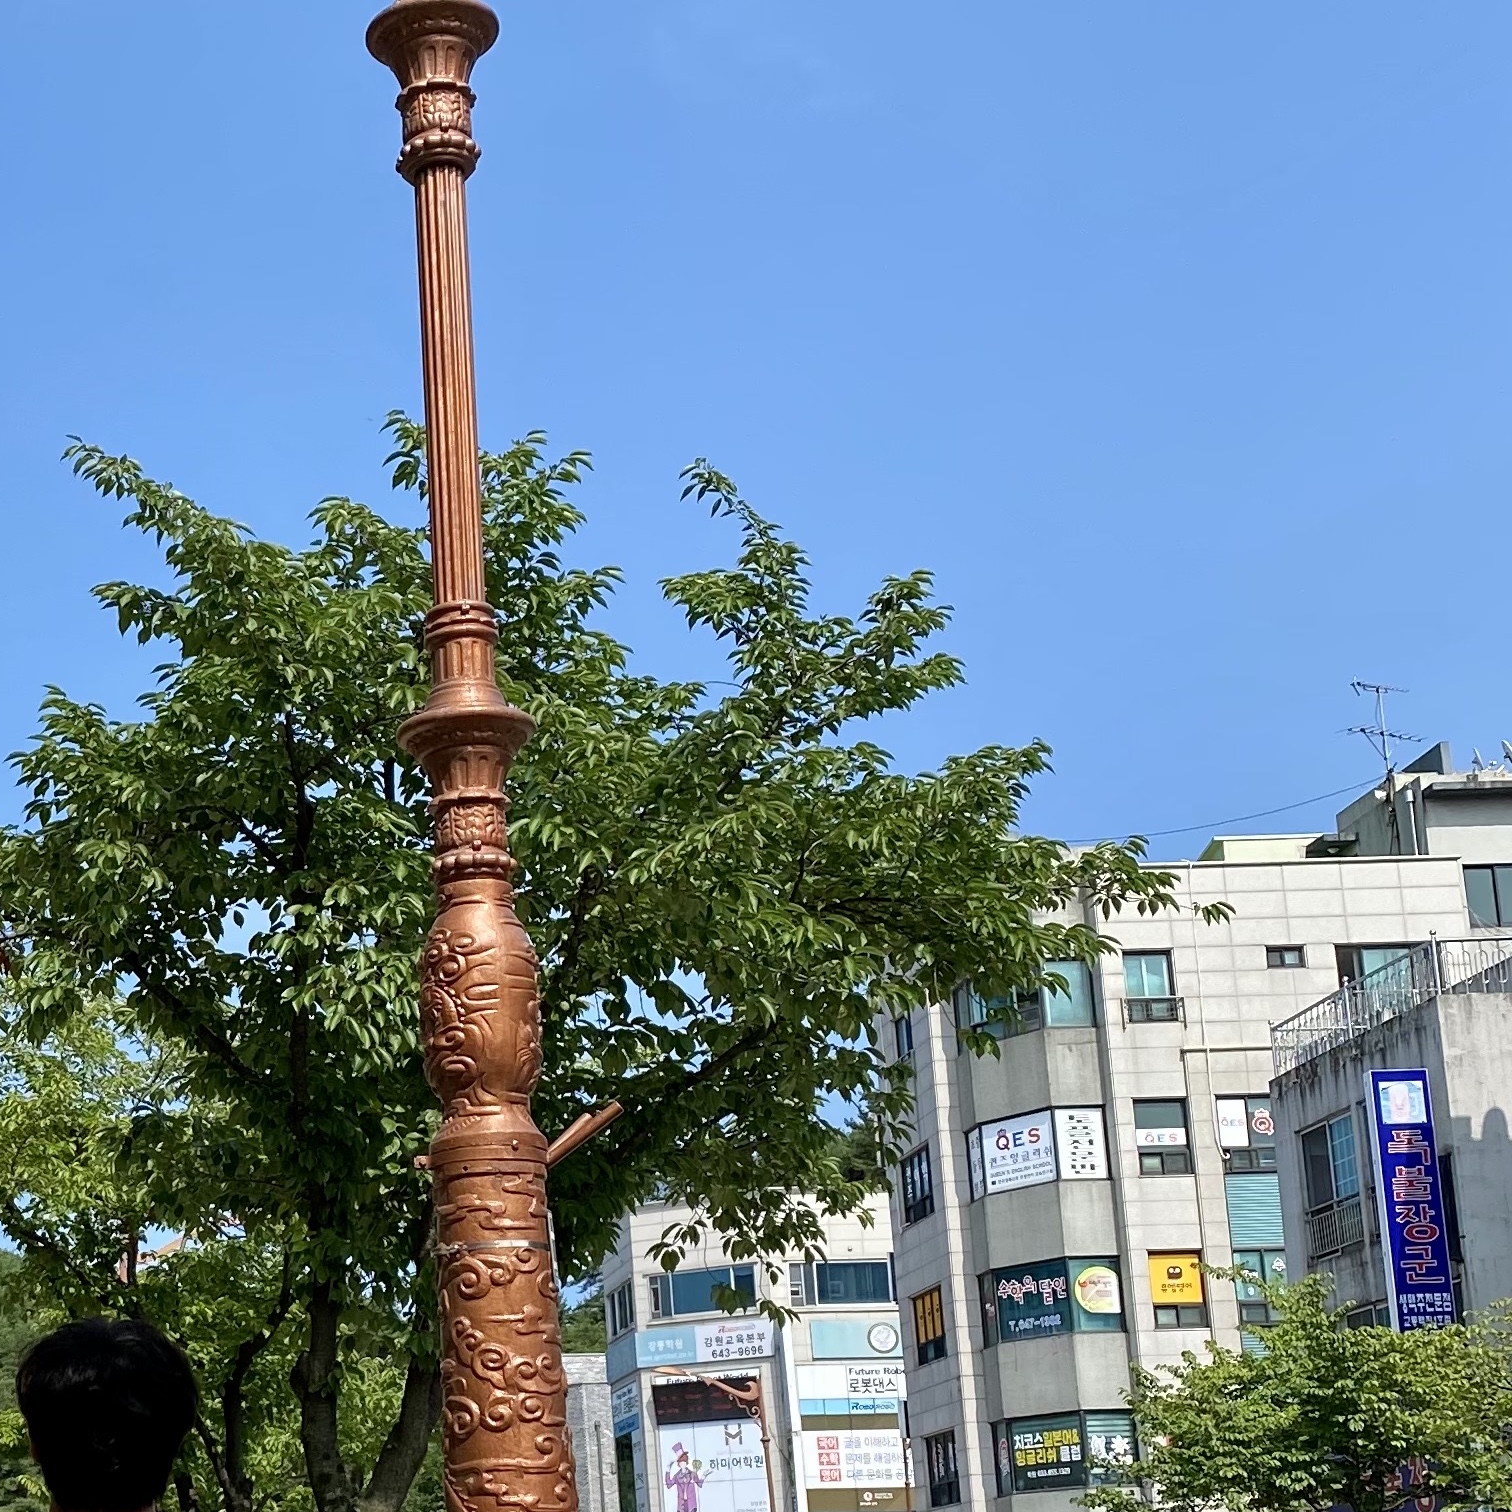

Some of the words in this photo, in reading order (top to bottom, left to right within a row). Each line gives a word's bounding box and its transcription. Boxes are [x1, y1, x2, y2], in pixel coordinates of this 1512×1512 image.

[1220, 1117, 1245, 1127] QES
[995, 1127, 1041, 1151] QES
[1144, 1132, 1178, 1144] QES
[1388, 1129, 1445, 1285] 독불장군
[998, 1275, 1037, 1304] 수학의
[1038, 1277, 1067, 1305] 달인
[704, 1332, 766, 1348] 강원교육본부
[711, 1345, 764, 1359] 643-9696
[848, 1367, 881, 1376] Future
[849, 1377, 898, 1393] 로봇댄스
[819, 1452, 840, 1465] 수학
